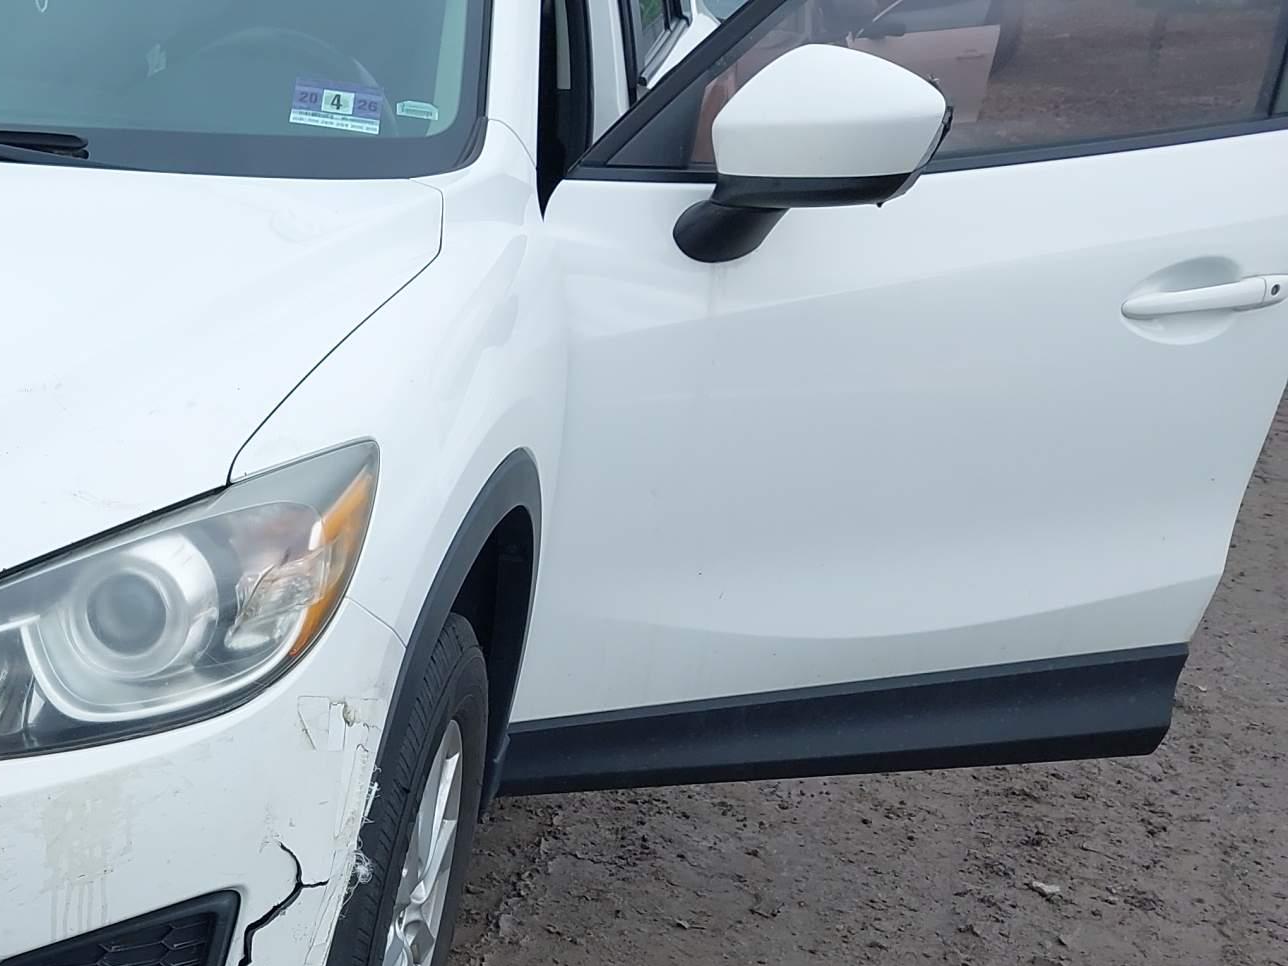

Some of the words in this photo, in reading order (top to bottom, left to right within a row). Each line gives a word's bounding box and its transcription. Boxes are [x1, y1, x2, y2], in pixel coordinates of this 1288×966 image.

[299, 91, 318, 104] 20
[330, 93, 343, 111] 4
[357, 99, 378, 113] 26
